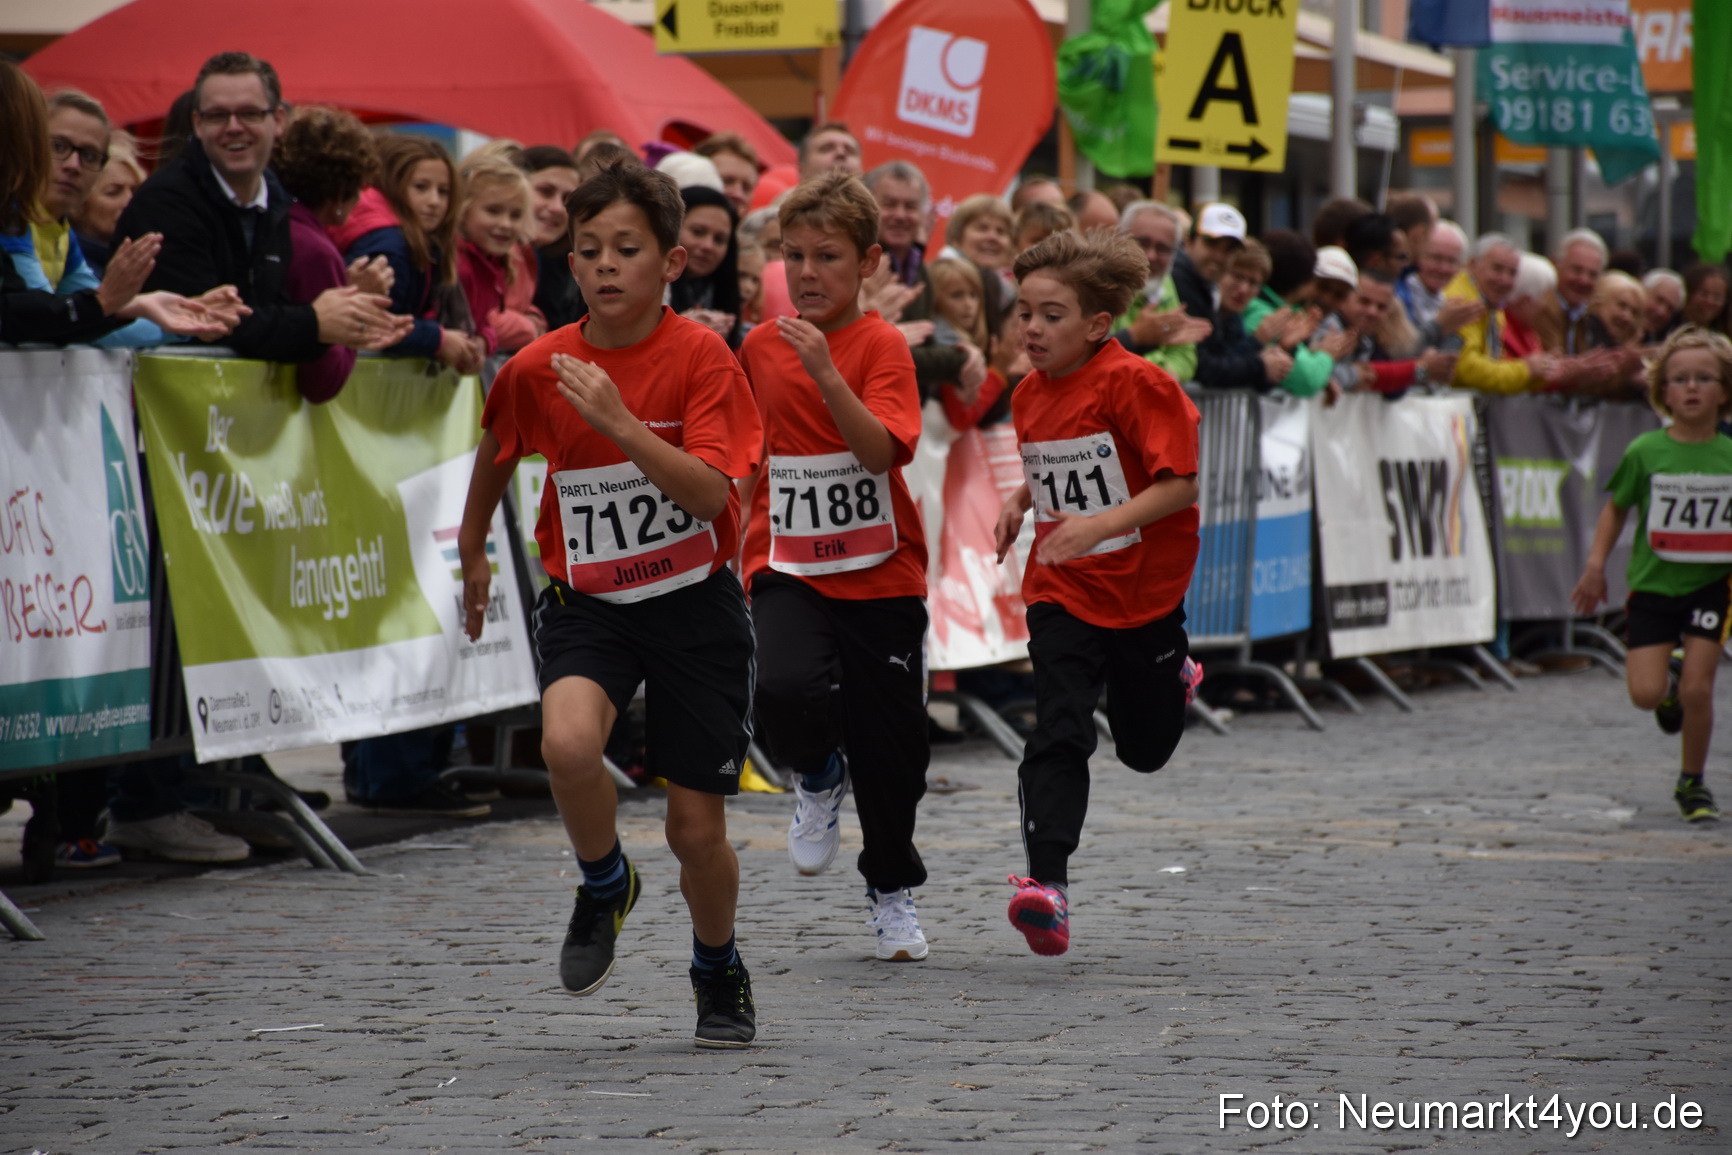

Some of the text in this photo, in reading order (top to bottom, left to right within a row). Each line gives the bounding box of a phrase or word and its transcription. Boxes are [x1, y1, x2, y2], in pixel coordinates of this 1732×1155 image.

[714, 21, 778, 37] Freibad
[1187, 31, 1259, 125] A
[906, 87, 969, 125] DKMS
[205, 405, 234, 452] Der
[1042, 450, 1093, 465] Neumarkt
[771, 464, 865, 480] PARTL Neumarkt
[560, 483, 598, 498] PARTL
[813, 539, 847, 558] Erik
[290, 534, 386, 621] langgeht!
[613, 557, 674, 586] Julian
[1691, 609, 1720, 630] 10
